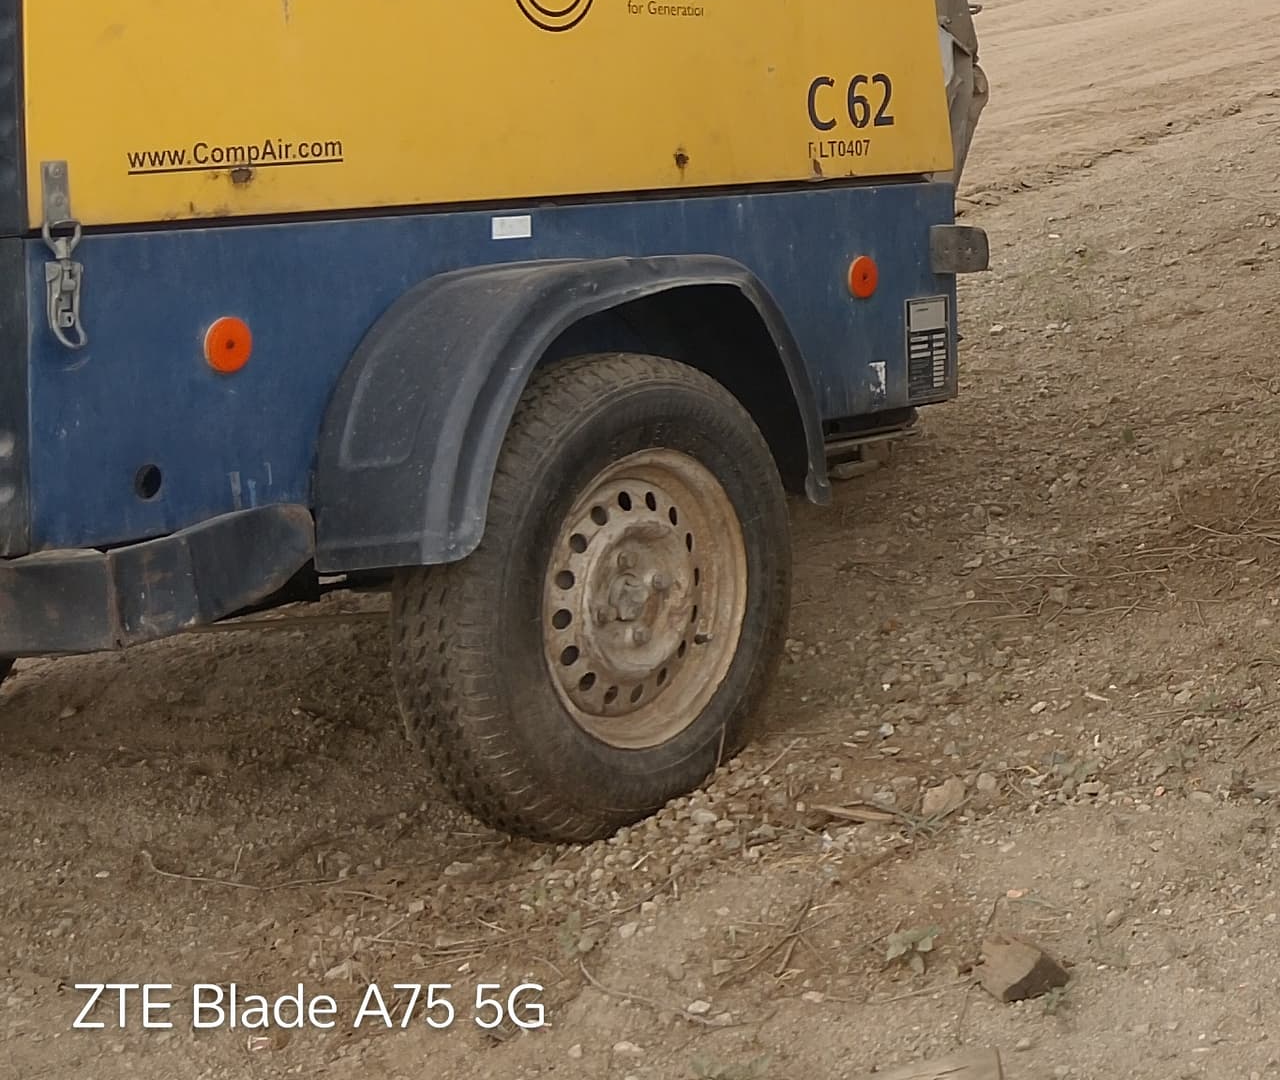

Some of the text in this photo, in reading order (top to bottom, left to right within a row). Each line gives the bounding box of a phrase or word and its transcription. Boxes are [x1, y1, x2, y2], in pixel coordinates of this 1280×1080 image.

[627, 1, 643, 15] for
[808, 73, 894, 131] C 62
[127, 139, 343, 169] www.CompAir.com
